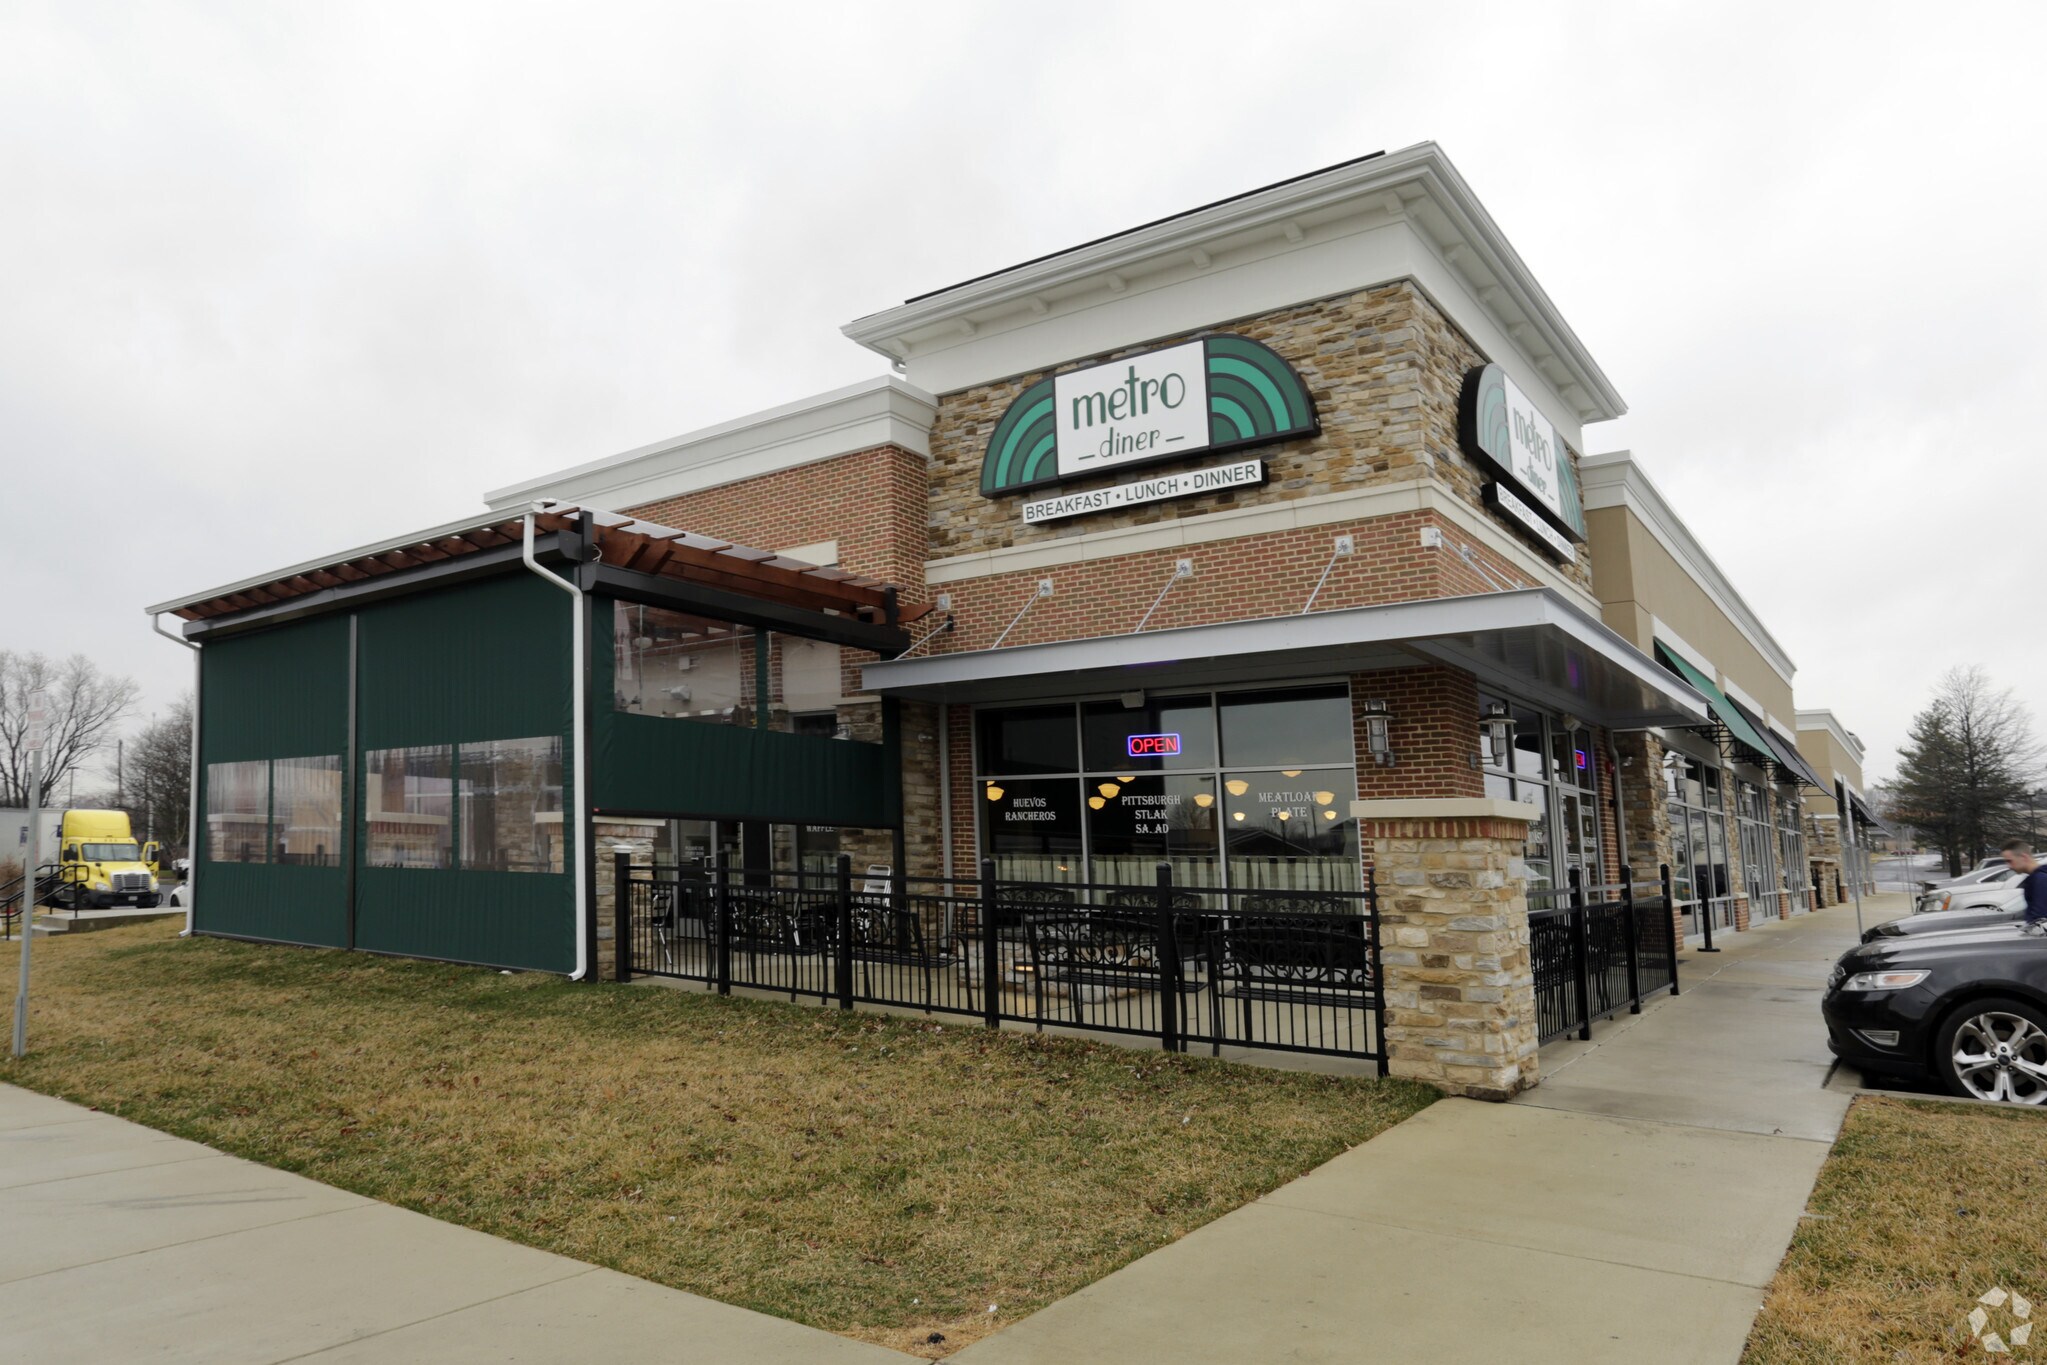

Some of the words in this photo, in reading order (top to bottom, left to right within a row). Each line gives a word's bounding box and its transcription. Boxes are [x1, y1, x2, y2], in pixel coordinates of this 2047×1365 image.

[1072, 365, 1186, 430] metro
[1100, 426, 1160, 458] diner
[1513, 406, 1552, 471] metro
[1026, 491, 1111, 520] BREAKFAST
[1125, 478, 1179, 502] LUNCH
[1194, 464, 1257, 488] DINNER
[1131, 737, 1177, 754] OPEN
[1013, 796, 1047, 808] HUEVOS
[1121, 795, 1181, 806] PITTSBURGH
[1005, 811, 1056, 821] RANCHEROS
[1135, 823, 1169, 834] SAAD
